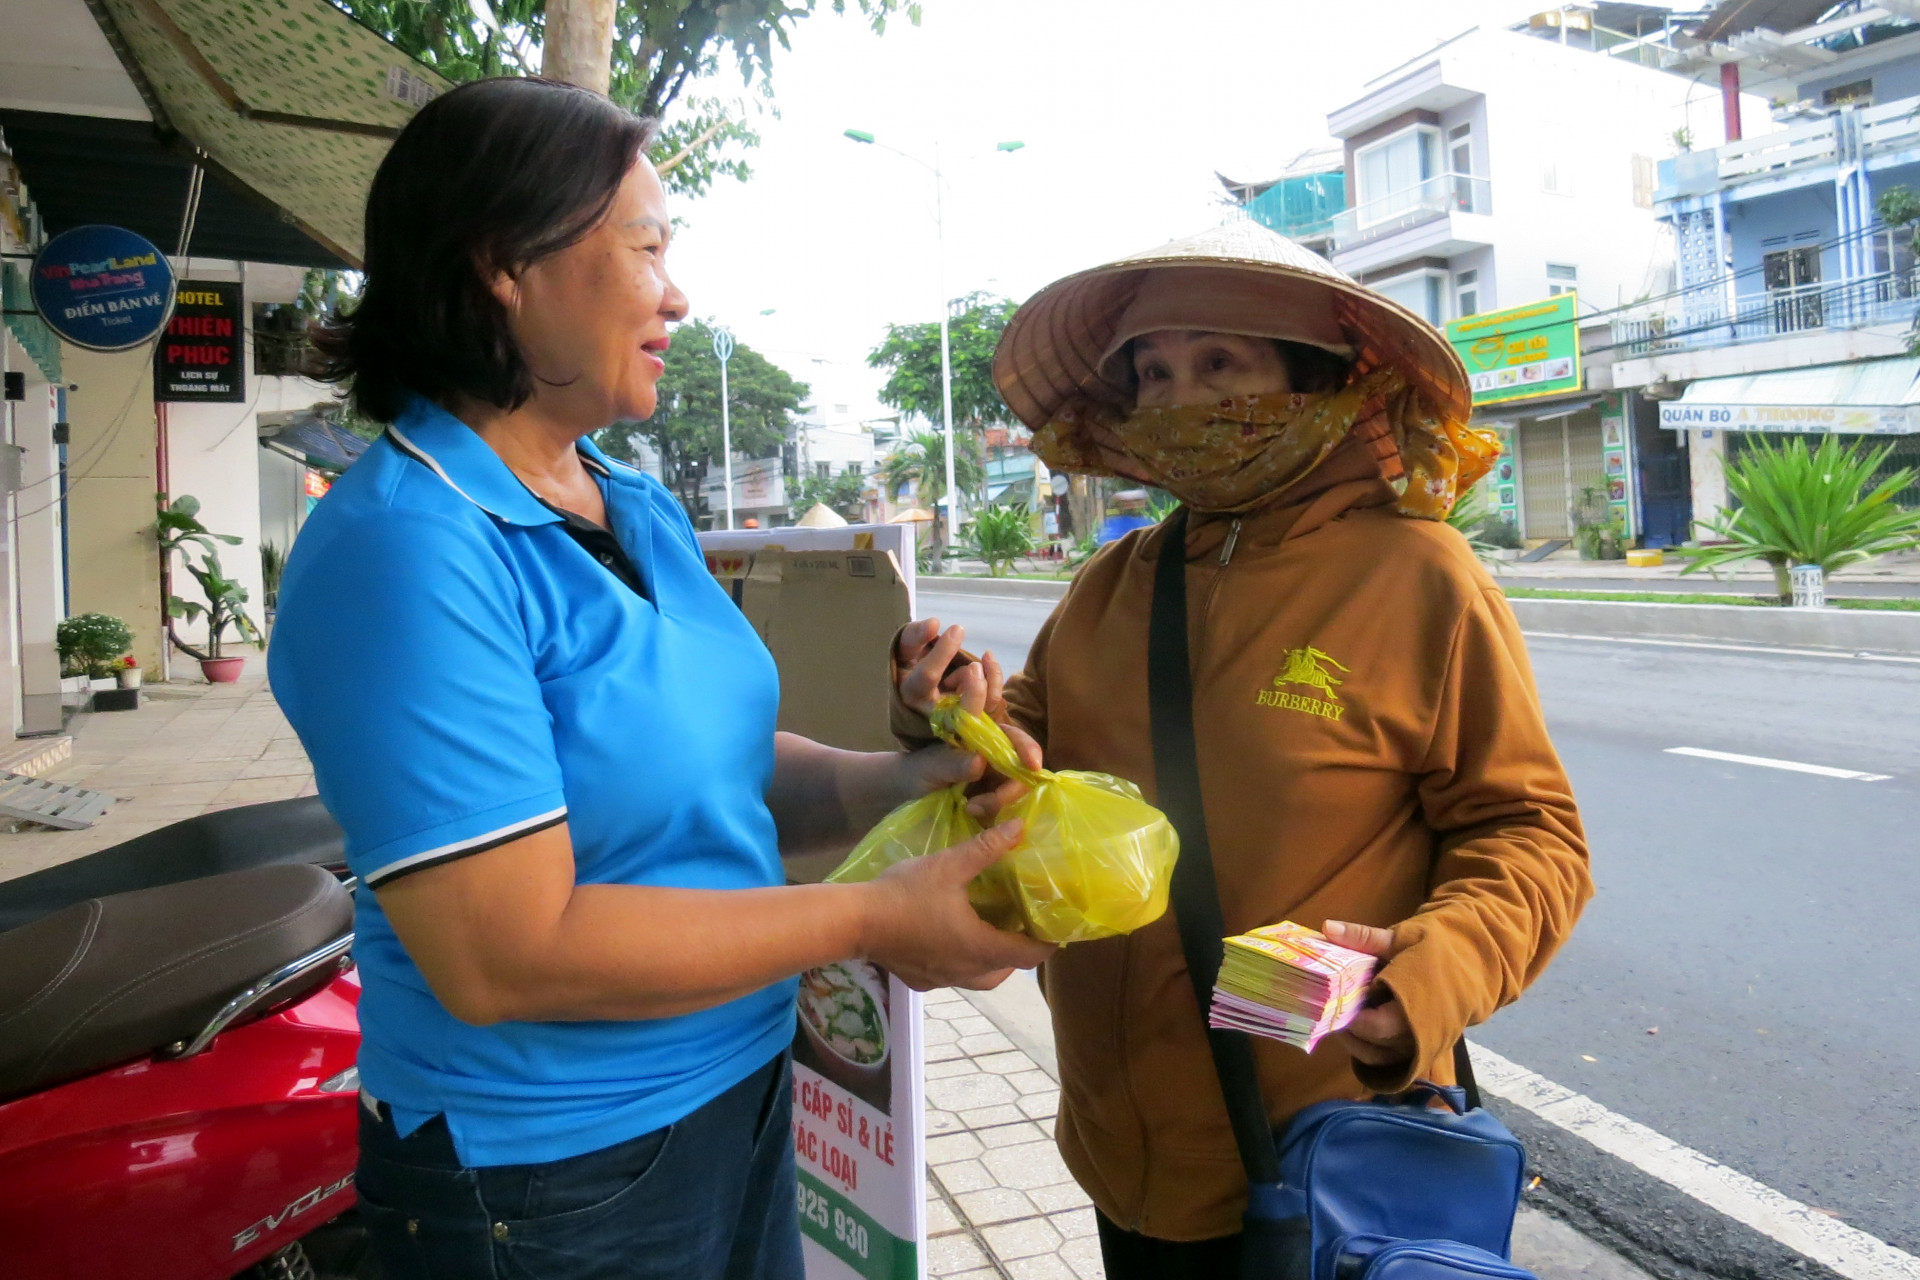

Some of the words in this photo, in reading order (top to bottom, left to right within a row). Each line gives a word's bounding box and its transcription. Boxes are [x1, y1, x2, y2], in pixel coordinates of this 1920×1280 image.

[64, 301, 105, 320] ĐIỂM
[176, 291, 223, 306] HOTEL
[167, 343, 231, 366] PHÚC
[1662, 406, 1703, 422] QUÁN
[1256, 689, 1344, 722] BURBERRY
[802, 1079, 832, 1122] CẤP
[859, 1115, 870, 1150] &
[875, 1122, 895, 1167] LẺ
[793, 1121, 817, 1164] ÁC
[821, 1141, 857, 1192] LOẠI
[797, 1181, 829, 1230] 925
[834, 1208, 868, 1259] 930
